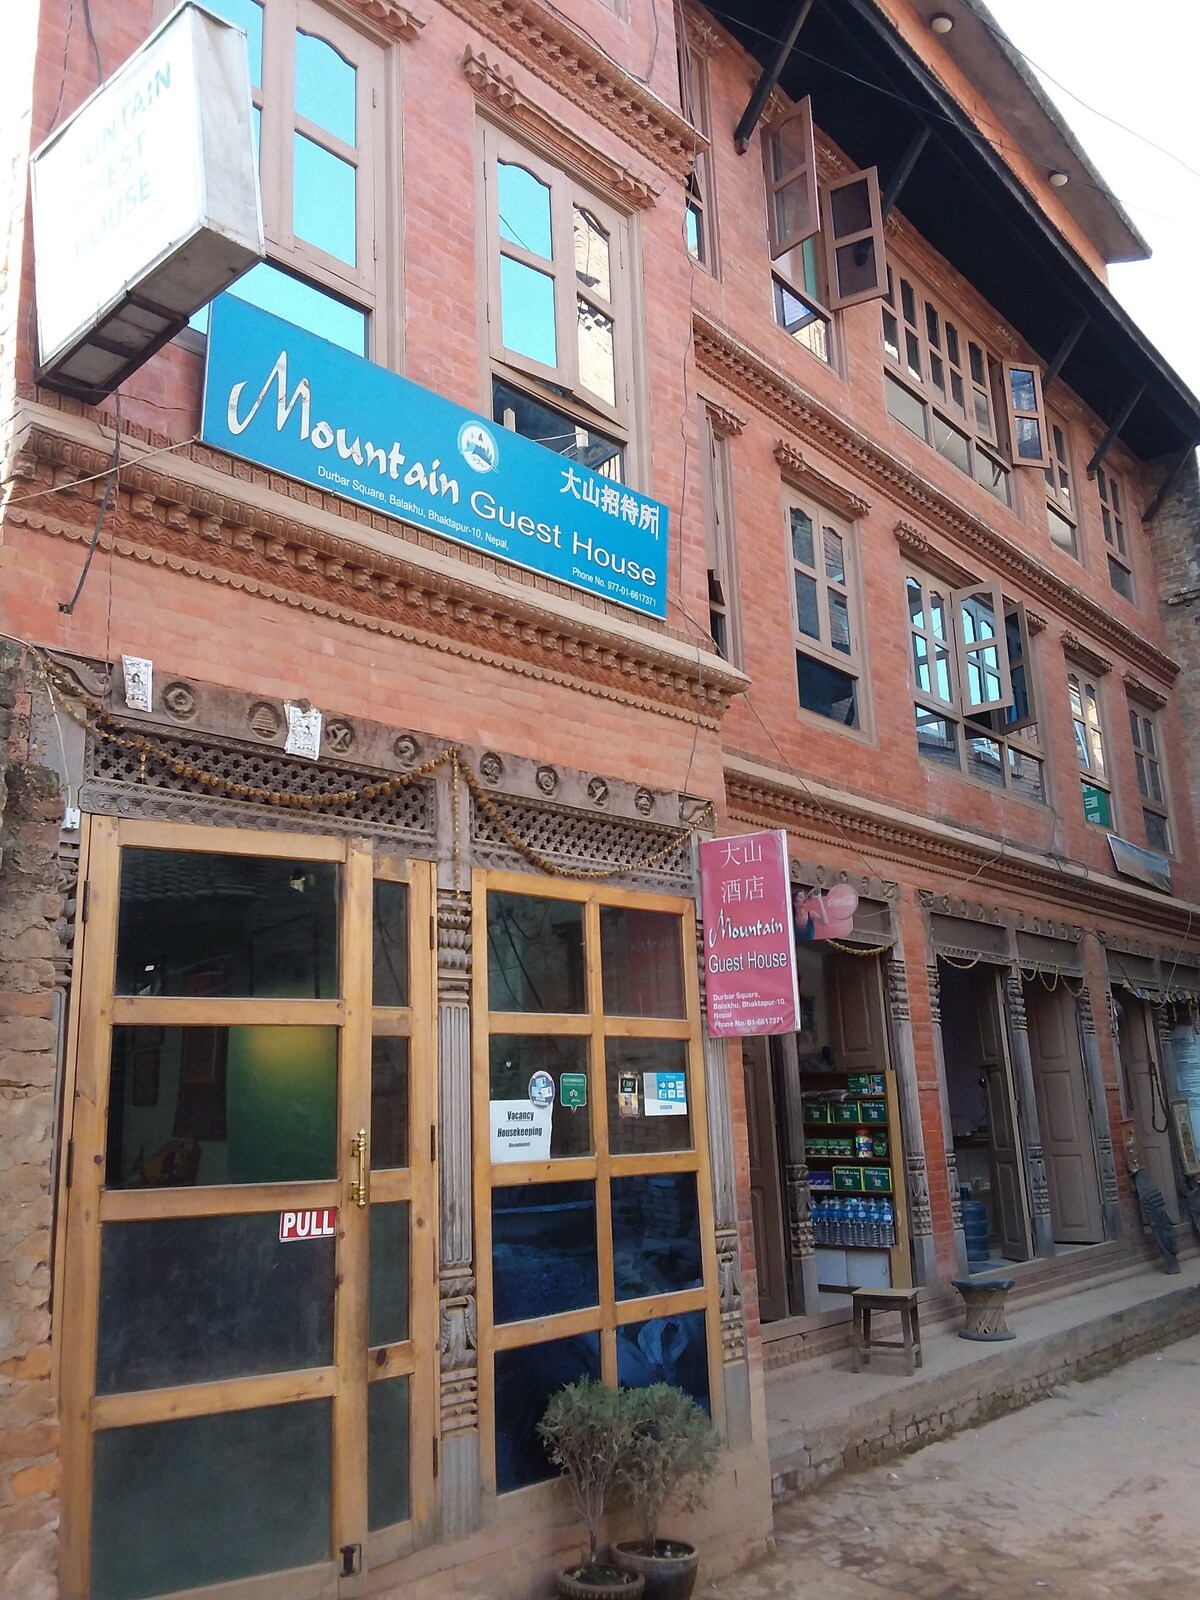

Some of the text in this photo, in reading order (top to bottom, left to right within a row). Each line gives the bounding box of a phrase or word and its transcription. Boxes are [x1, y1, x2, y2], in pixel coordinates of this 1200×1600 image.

[83, 60, 171, 164] UNTAIN
[227, 350, 460, 505] Mountain
[317, 465, 509, 550] Durbar Square, Balakhu, Bhaktapur-10, Nepal,
[560, 467, 659, 540] 大山招待所
[470, 490, 657, 586] Guest House
[572, 566, 593, 583] Phone
[595, 575, 606, 588] No.
[720, 840, 763, 868] 大山
[721, 875, 764, 903] 酒店
[709, 909, 784, 948] Mountain
[709, 951, 787, 973] Guest House
[713, 992, 760, 1001] Durbar Square,
[713, 998, 787, 1010] Balakhu, Bhaktapur-10,
[713, 1011, 732, 1019] Nepal
[507, 1110, 534, 1121] Vacancy
[497, 1126, 542, 1138] Housekeeping
[282, 1210, 334, 1237] PULL
